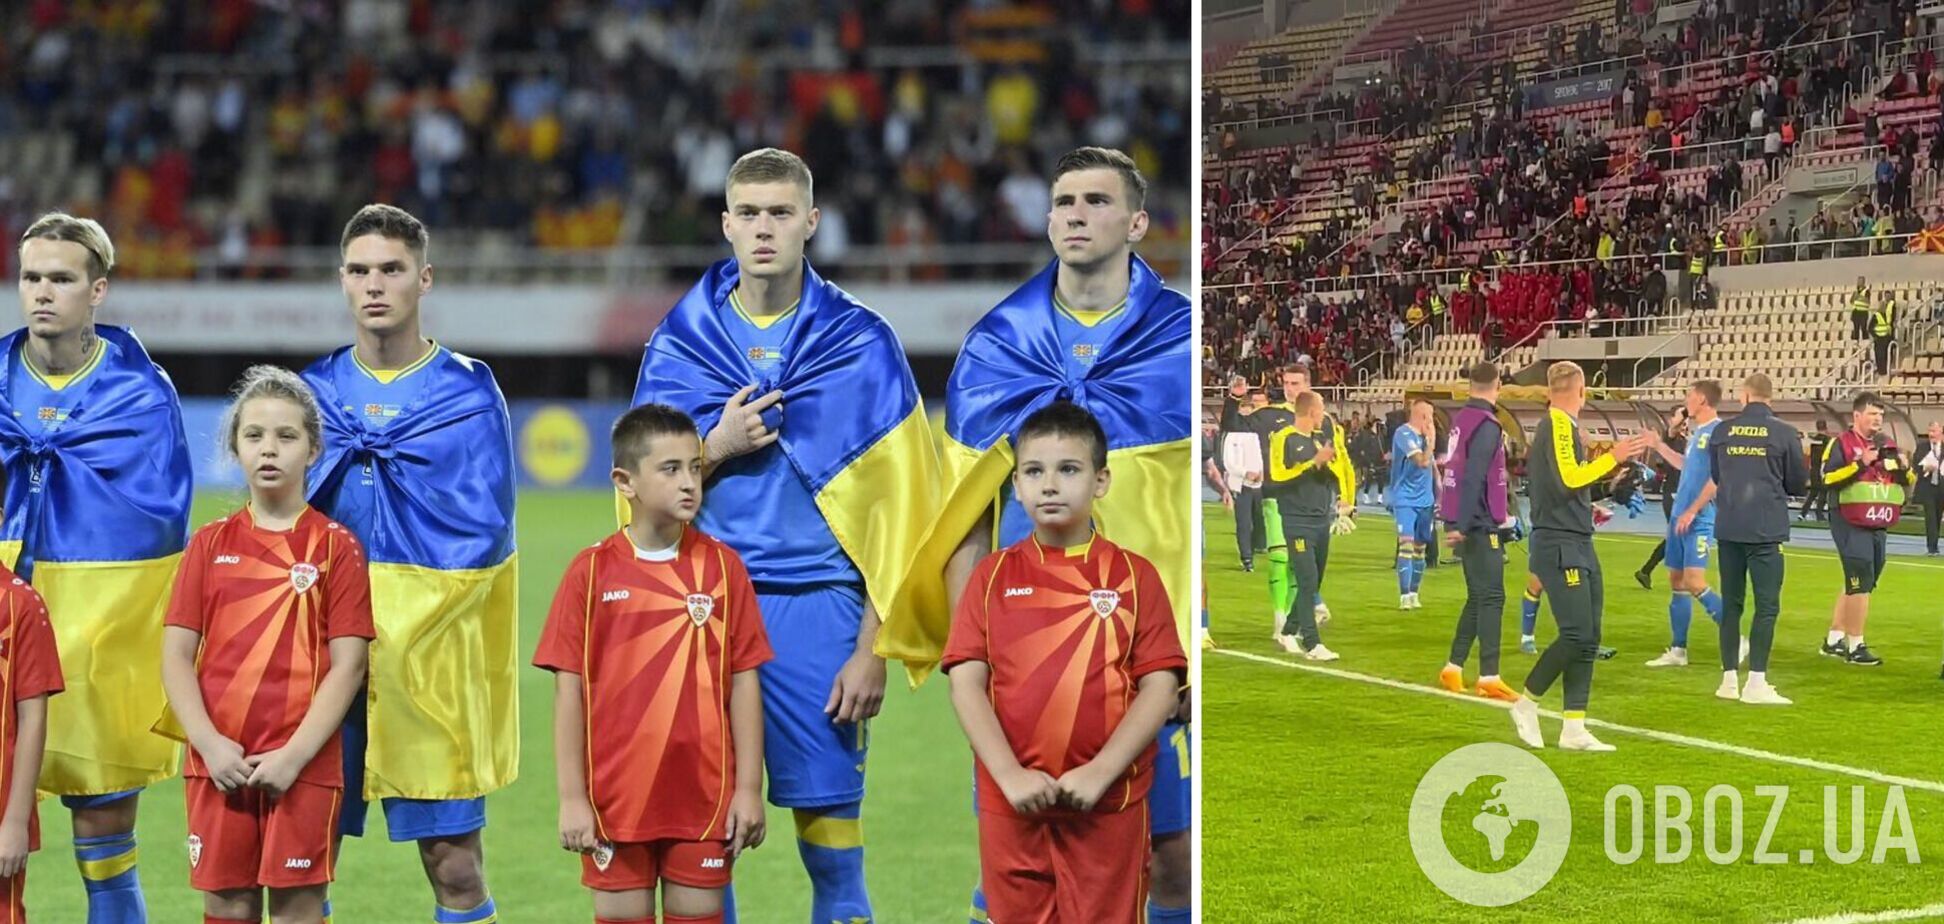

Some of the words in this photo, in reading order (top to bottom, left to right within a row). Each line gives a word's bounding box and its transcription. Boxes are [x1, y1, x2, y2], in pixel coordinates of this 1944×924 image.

[1869, 484, 1890, 499] TV
[1866, 506, 1894, 522] 440
[214, 555, 241, 565] JAKO
[602, 589, 630, 602] JAKO
[1004, 587, 1034, 597] JAKO
[285, 858, 311, 868] JAKO
